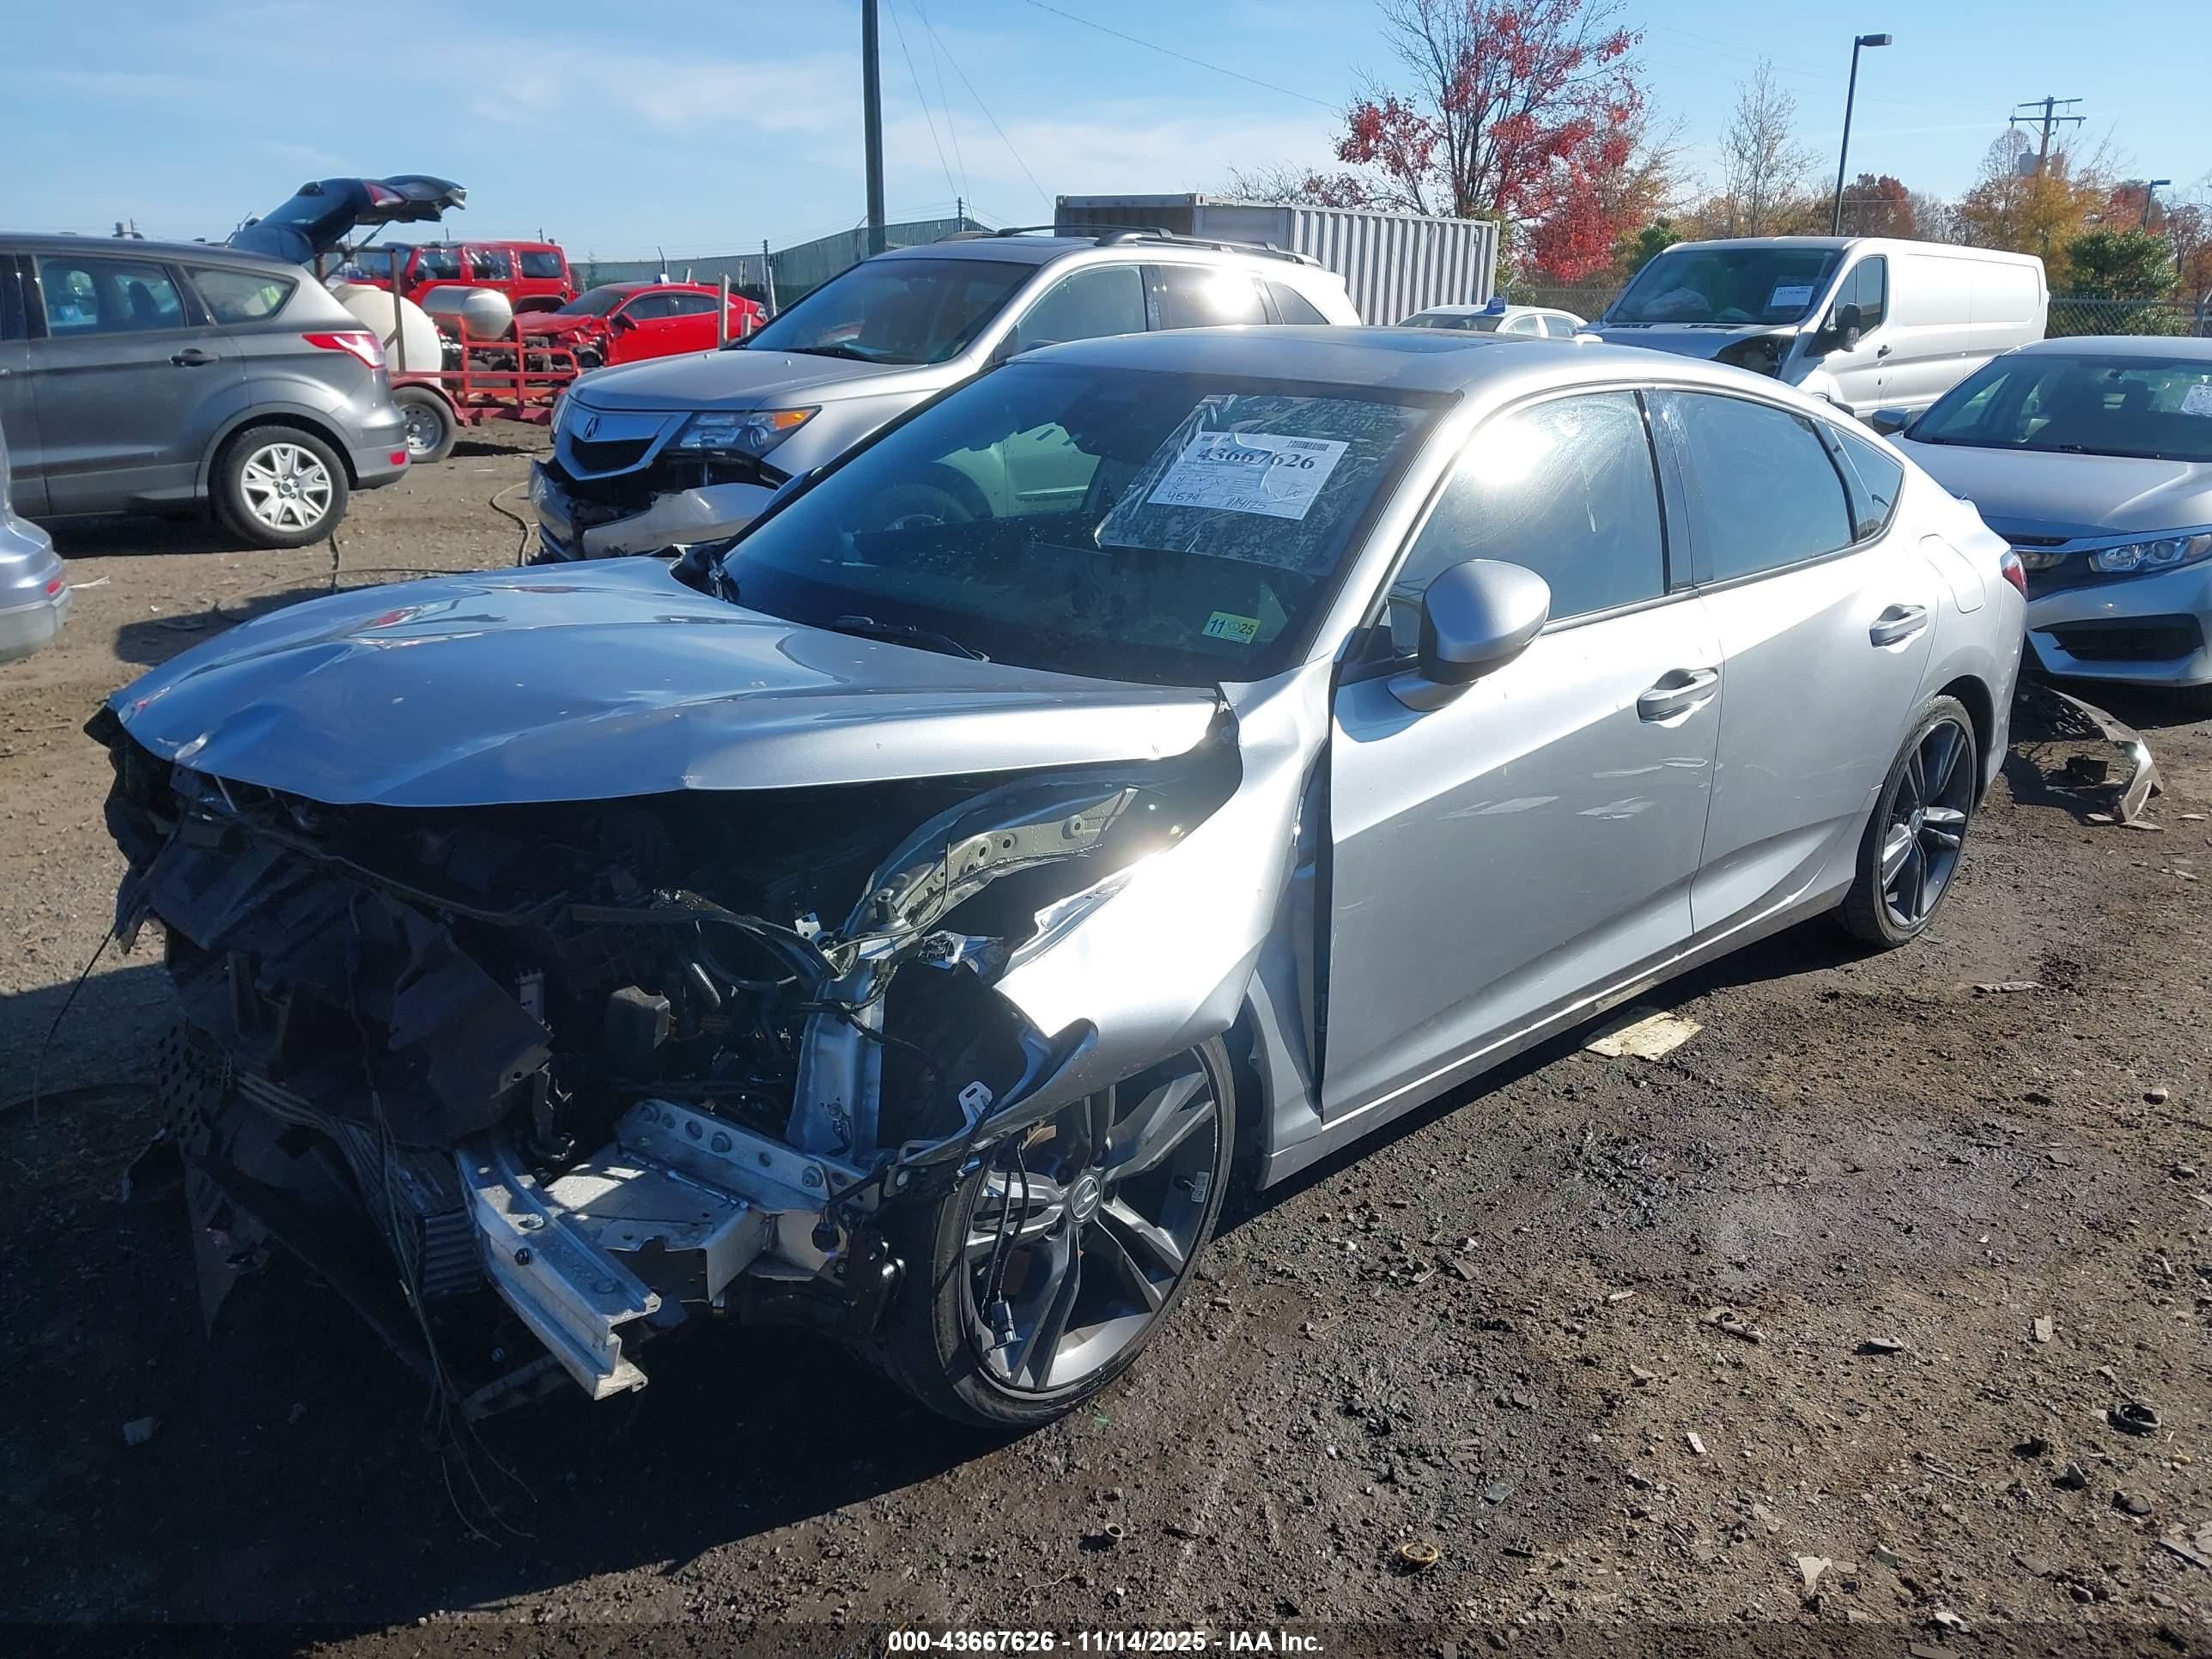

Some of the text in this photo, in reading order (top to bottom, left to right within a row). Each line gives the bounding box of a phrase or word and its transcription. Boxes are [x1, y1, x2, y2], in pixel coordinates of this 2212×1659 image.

[1196, 447, 1320, 470] 43667626
[1210, 617, 1255, 635] 11 25
